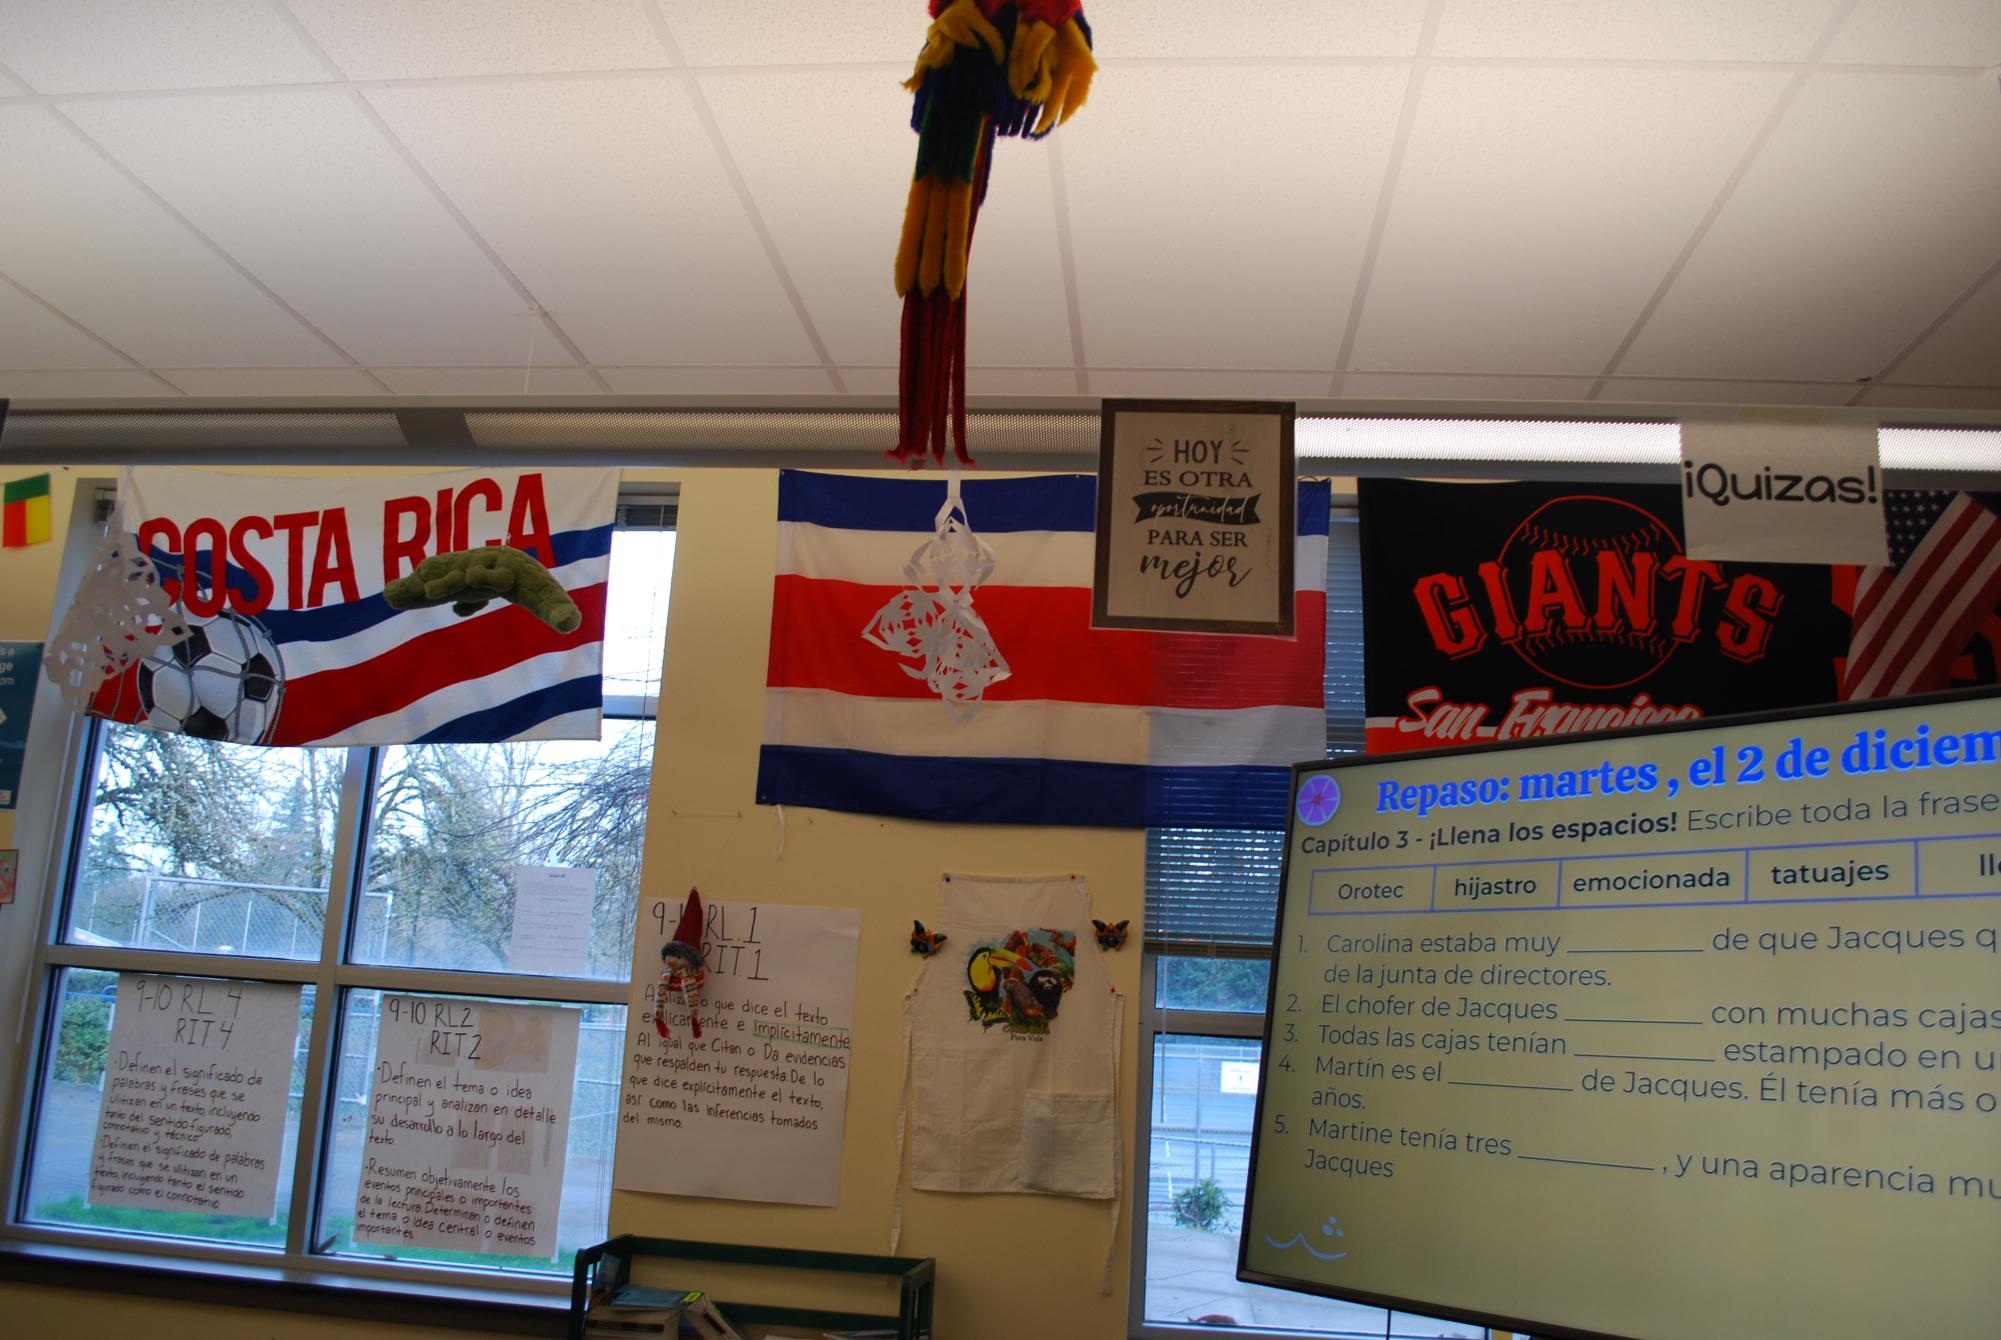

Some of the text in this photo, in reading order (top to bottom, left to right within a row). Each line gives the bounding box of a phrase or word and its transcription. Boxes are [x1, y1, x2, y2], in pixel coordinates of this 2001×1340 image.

[1174, 439, 1224, 464] HOY
[1143, 470, 1253, 488] ES OTRA
[1683, 460, 1878, 506] ¡Quizas!
[1150, 495, 1249, 526] oportunidad
[1147, 529, 1249, 547] PARA SER
[1140, 551, 1252, 599] mejor
[1412, 551, 1784, 665] GIANTS
[1400, 686, 1490, 740] San
[1376, 776, 1511, 817] Repaso:
[1519, 760, 1658, 802] martes
[1688, 745, 1726, 788] el
[1735, 746, 1765, 786] 2
[1775, 737, 1830, 781] de
[1301, 791, 2000, 858] Capítulo 3 ¡Llena los espacios! Escribe toda la frase
[1572, 866, 1730, 892] emocionada
[1771, 859, 1890, 887] tatuajes
[1338, 882, 1404, 900] Orotec
[1454, 878, 1537, 900] hijastro
[1327, 932, 1413, 954] Carolina
[1420, 932, 1496, 953] estaba
[1504, 934, 1561, 957] muy
[1712, 927, 1749, 951] de
[1758, 931, 1818, 956] que
[1826, 925, 1965, 954] Jacques
[1323, 964, 1613, 989] de la junta de directores.
[714, 999, 828, 1026] que dice el texto
[1286, 993, 1302, 1013] 2.
[1321, 994, 1340, 1015] El
[1346, 995, 1416, 1017] chofer
[1421, 996, 1450, 1017] de
[1456, 997, 1558, 1023] Jacques
[1711, 1004, 1766, 1025] con
[1777, 1001, 1908, 1028] muchas
[637, 1032, 650, 1048] Al
[659, 1037, 682, 1055] igual
[688, 1041, 706, 1056] que
[711, 1038, 742, 1054] Citan
[786, 1050, 846, 1069] evidencias
[1283, 1023, 1299, 1043] 3.
[1318, 1024, 1379, 1047] Todas
[1385, 1026, 1415, 1048] las
[1421, 1029, 1480, 1055] cajas
[1487, 1031, 1567, 1055] tenían
[1723, 1042, 1907, 1070] estampado
[1918, 1049, 1960, 1070] en
[165, 1059, 177, 1076] el
[183, 1063, 244, 1087] significado
[248, 1068, 263, 1086] de
[435, 1075, 447, 1090] el
[453, 1068, 484, 1094] tema
[490, 1086, 498, 1096] o
[507, 1077, 532, 1100] idea
[633, 1053, 652, 1071] que
[657, 1055, 711, 1074] respalden
[714, 1061, 727, 1074] tu
[791, 1069, 807, 1085] De
[813, 1071, 825, 1087] lo
[1278, 1054, 1295, 1073] 4.
[1391, 1063, 1416, 1080] es
[1422, 1061, 1442, 1082] el
[1581, 1069, 1615, 1093] de
[1622, 1071, 1749, 1102] Jacques.
[1760, 1073, 1786, 1102] Él
[1797, 1080, 1878, 1108] tenía
[1890, 1085, 1965, 1112] más
[1976, 1093, 1997, 1113] o
[112, 1077, 245, 1102] palabras y frases que se
[630, 1074, 648, 1089] que
[653, 1074, 678, 1089] dice
[771, 1088, 782, 1103] el
[1311, 1087, 1366, 1109] años.
[374, 1092, 557, 1124] principal y analizan en detalle
[623, 1112, 640, 1124] del
[650, 1097, 677, 1110] como
[683, 1098, 700, 1114] las
[371, 1113, 385, 1126] su
[390, 1113, 443, 1134] desarrollo
[458, 1119, 469, 1138] lo
[473, 1119, 503, 1148] largo
[506, 1130, 525, 1145] del
[1273, 1114, 1289, 1135] 5.
[1308, 1118, 1393, 1144] Martine
[1400, 1126, 1457, 1151] tenía
[1465, 1131, 1512, 1156] tres
[1702, 1154, 1759, 1179] una
[1769, 1160, 1935, 1195] aparencia
[1304, 1149, 1393, 1179] Jacques
